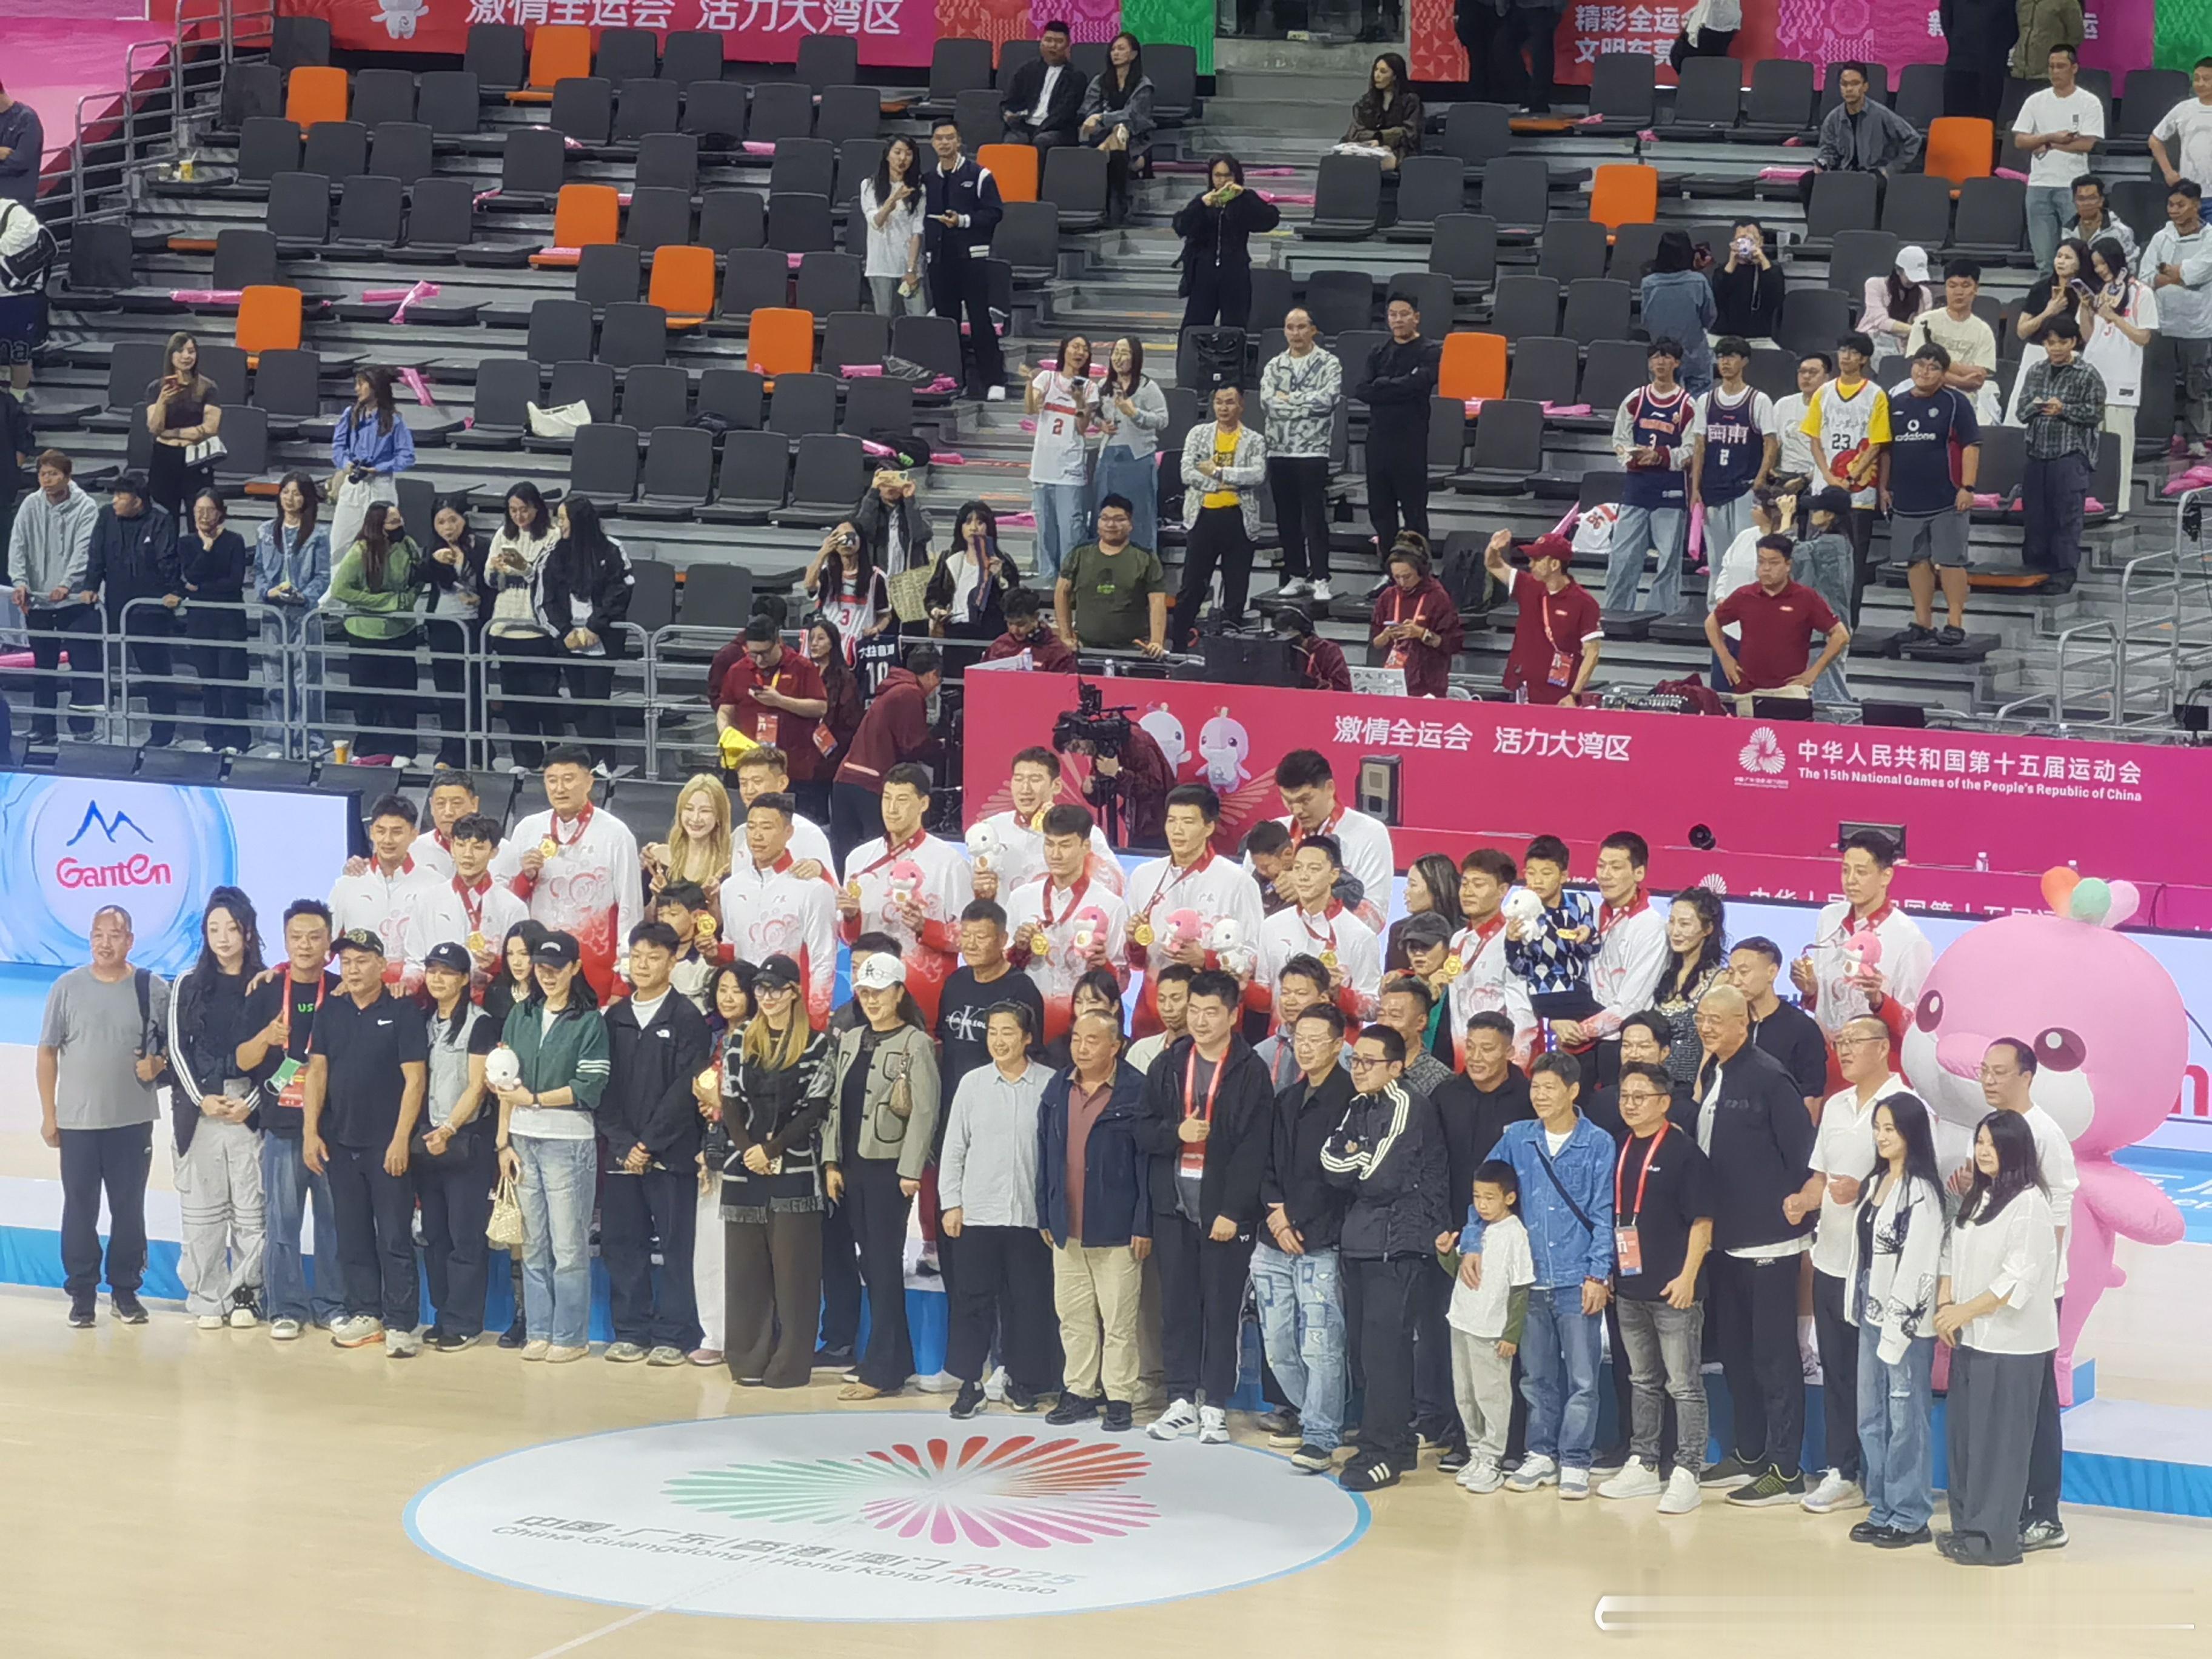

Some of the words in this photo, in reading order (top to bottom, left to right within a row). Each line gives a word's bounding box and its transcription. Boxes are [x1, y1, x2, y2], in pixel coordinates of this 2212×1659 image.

[1832, 433, 1851, 451] 23
[1332, 715, 1473, 751] 激情全运会
[1492, 725, 1632, 762] 活力大湾区
[1797, 738, 2142, 785] 中华人民共和国第十五届运动会
[1798, 766, 1820, 780] The
[1824, 768, 1849, 782] 15th
[1851, 771, 1902, 785] National
[1904, 775, 1944, 789] Games
[1946, 777, 1960, 789] of
[1962, 778, 1982, 791] the
[1983, 780, 2034, 797] People's
[2036, 783, 2088, 800] Republic
[2091, 786, 2105, 799] of
[2106, 788, 2142, 802] China
[768, 1557, 851, 1572] Hong
[854, 1566, 933, 1581] Kong
[954, 1577, 1057, 1594] Macao
[947, 1564, 1088, 1584] 2025
